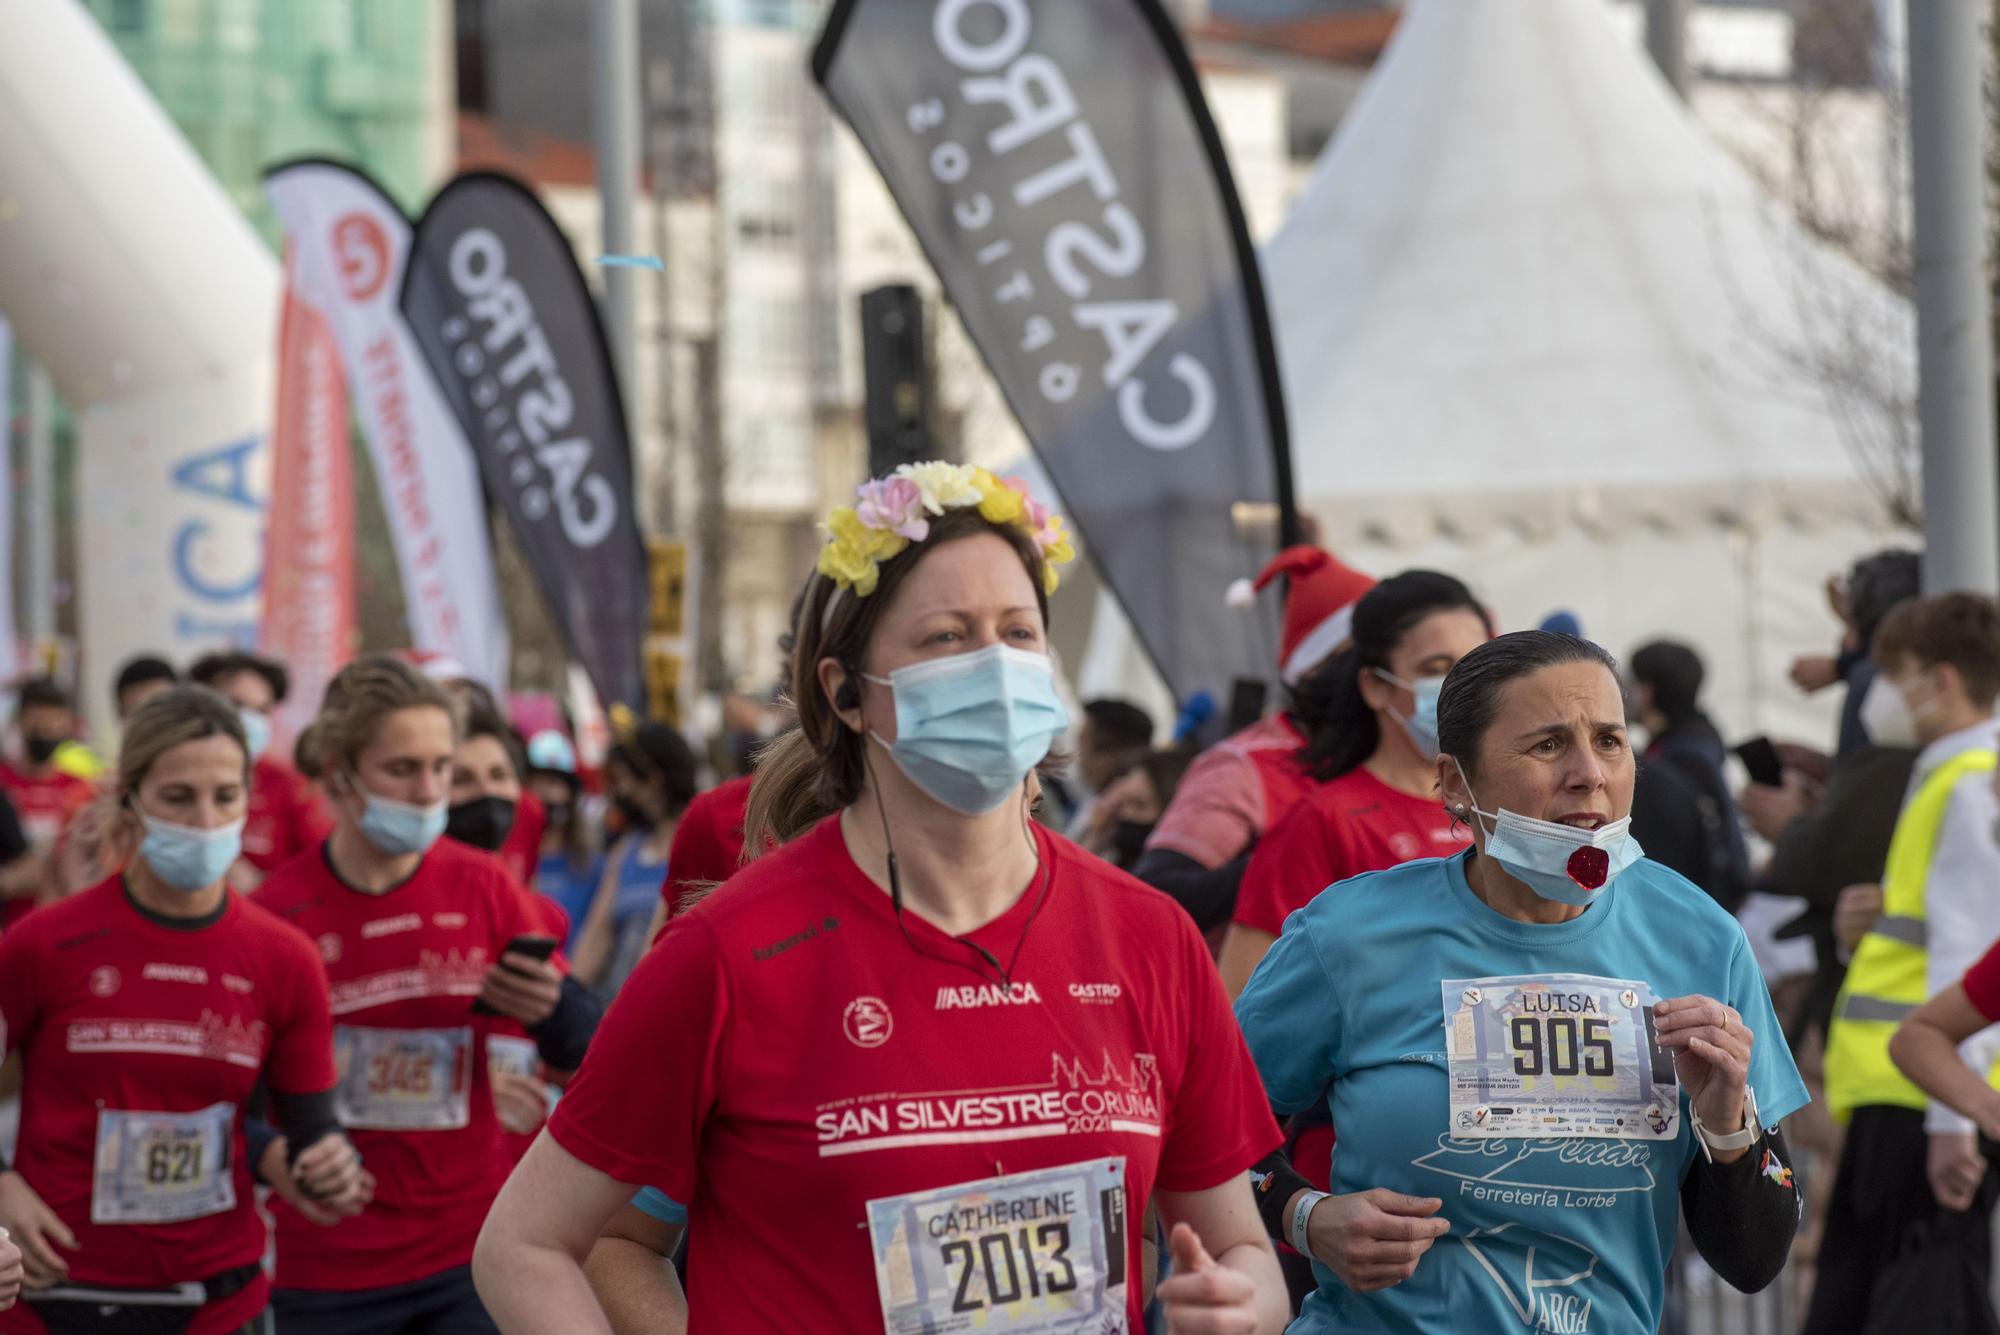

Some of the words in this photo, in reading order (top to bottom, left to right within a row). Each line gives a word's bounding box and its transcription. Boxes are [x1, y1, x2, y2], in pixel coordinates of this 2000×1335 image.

[1069, 983, 1121, 998] CASTRO
[1523, 993, 1597, 1013] LUISA
[1511, 1017, 1614, 1077] 905
[815, 1102, 889, 1142] SAN
[1066, 1116, 1112, 1134] 2021
[147, 1144, 202, 1183] 621
[1459, 1180, 1558, 1207] Ferretería
[1564, 1191, 1617, 1208] Lorbé
[928, 1191, 1077, 1238] CATHERINE
[940, 1221, 1077, 1314] 2013
